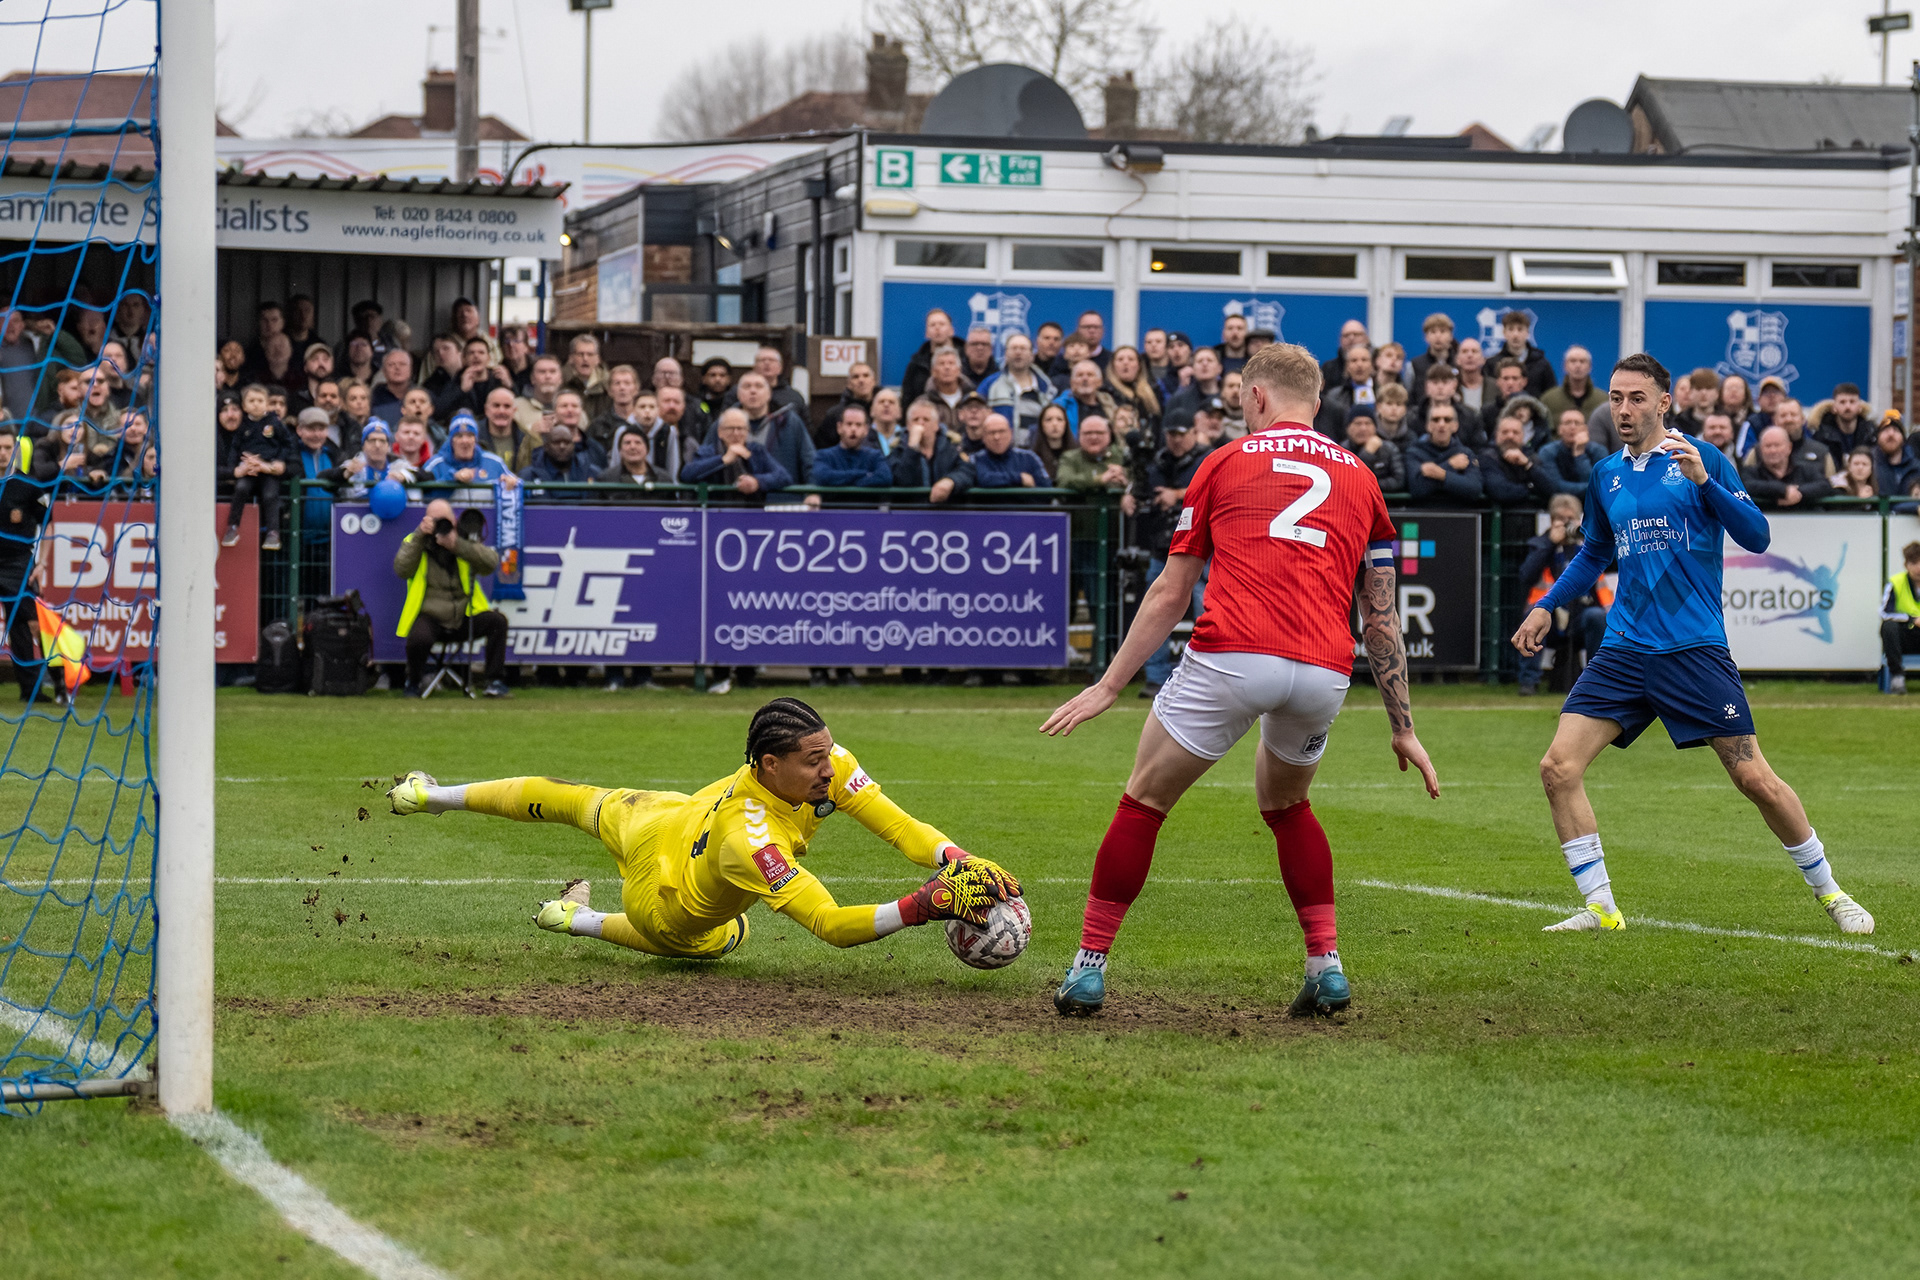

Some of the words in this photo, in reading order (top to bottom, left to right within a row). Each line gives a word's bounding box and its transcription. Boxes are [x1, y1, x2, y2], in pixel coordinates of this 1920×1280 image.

[881, 152, 909, 185] B
[1008, 156, 1038, 170] Fire
[1008, 171, 1037, 184] exit
[373, 205, 395, 221] Tel:
[402, 206, 429, 222] 020
[435, 207, 472, 223] 8424
[478, 209, 516, 225] 0800
[342, 224, 546, 244] www.nagleflooring.co.uk
[824, 344, 861, 363] EXIT
[1242, 438, 1359, 468] GRIMMER
[1269, 458, 1332, 548] 2
[1632, 515, 1668, 530] Brunel
[715, 528, 867, 573] 07525
[879, 530, 970, 574] 538
[982, 531, 1059, 575] 341
[727, 586, 1044, 618] www.cgscaffolding.co.uk
[1734, 615, 1760, 626] LTD
[714, 620, 1057, 651] cgscaffolding@yahoo.co.uk
[774, 865, 786, 875] CUP
